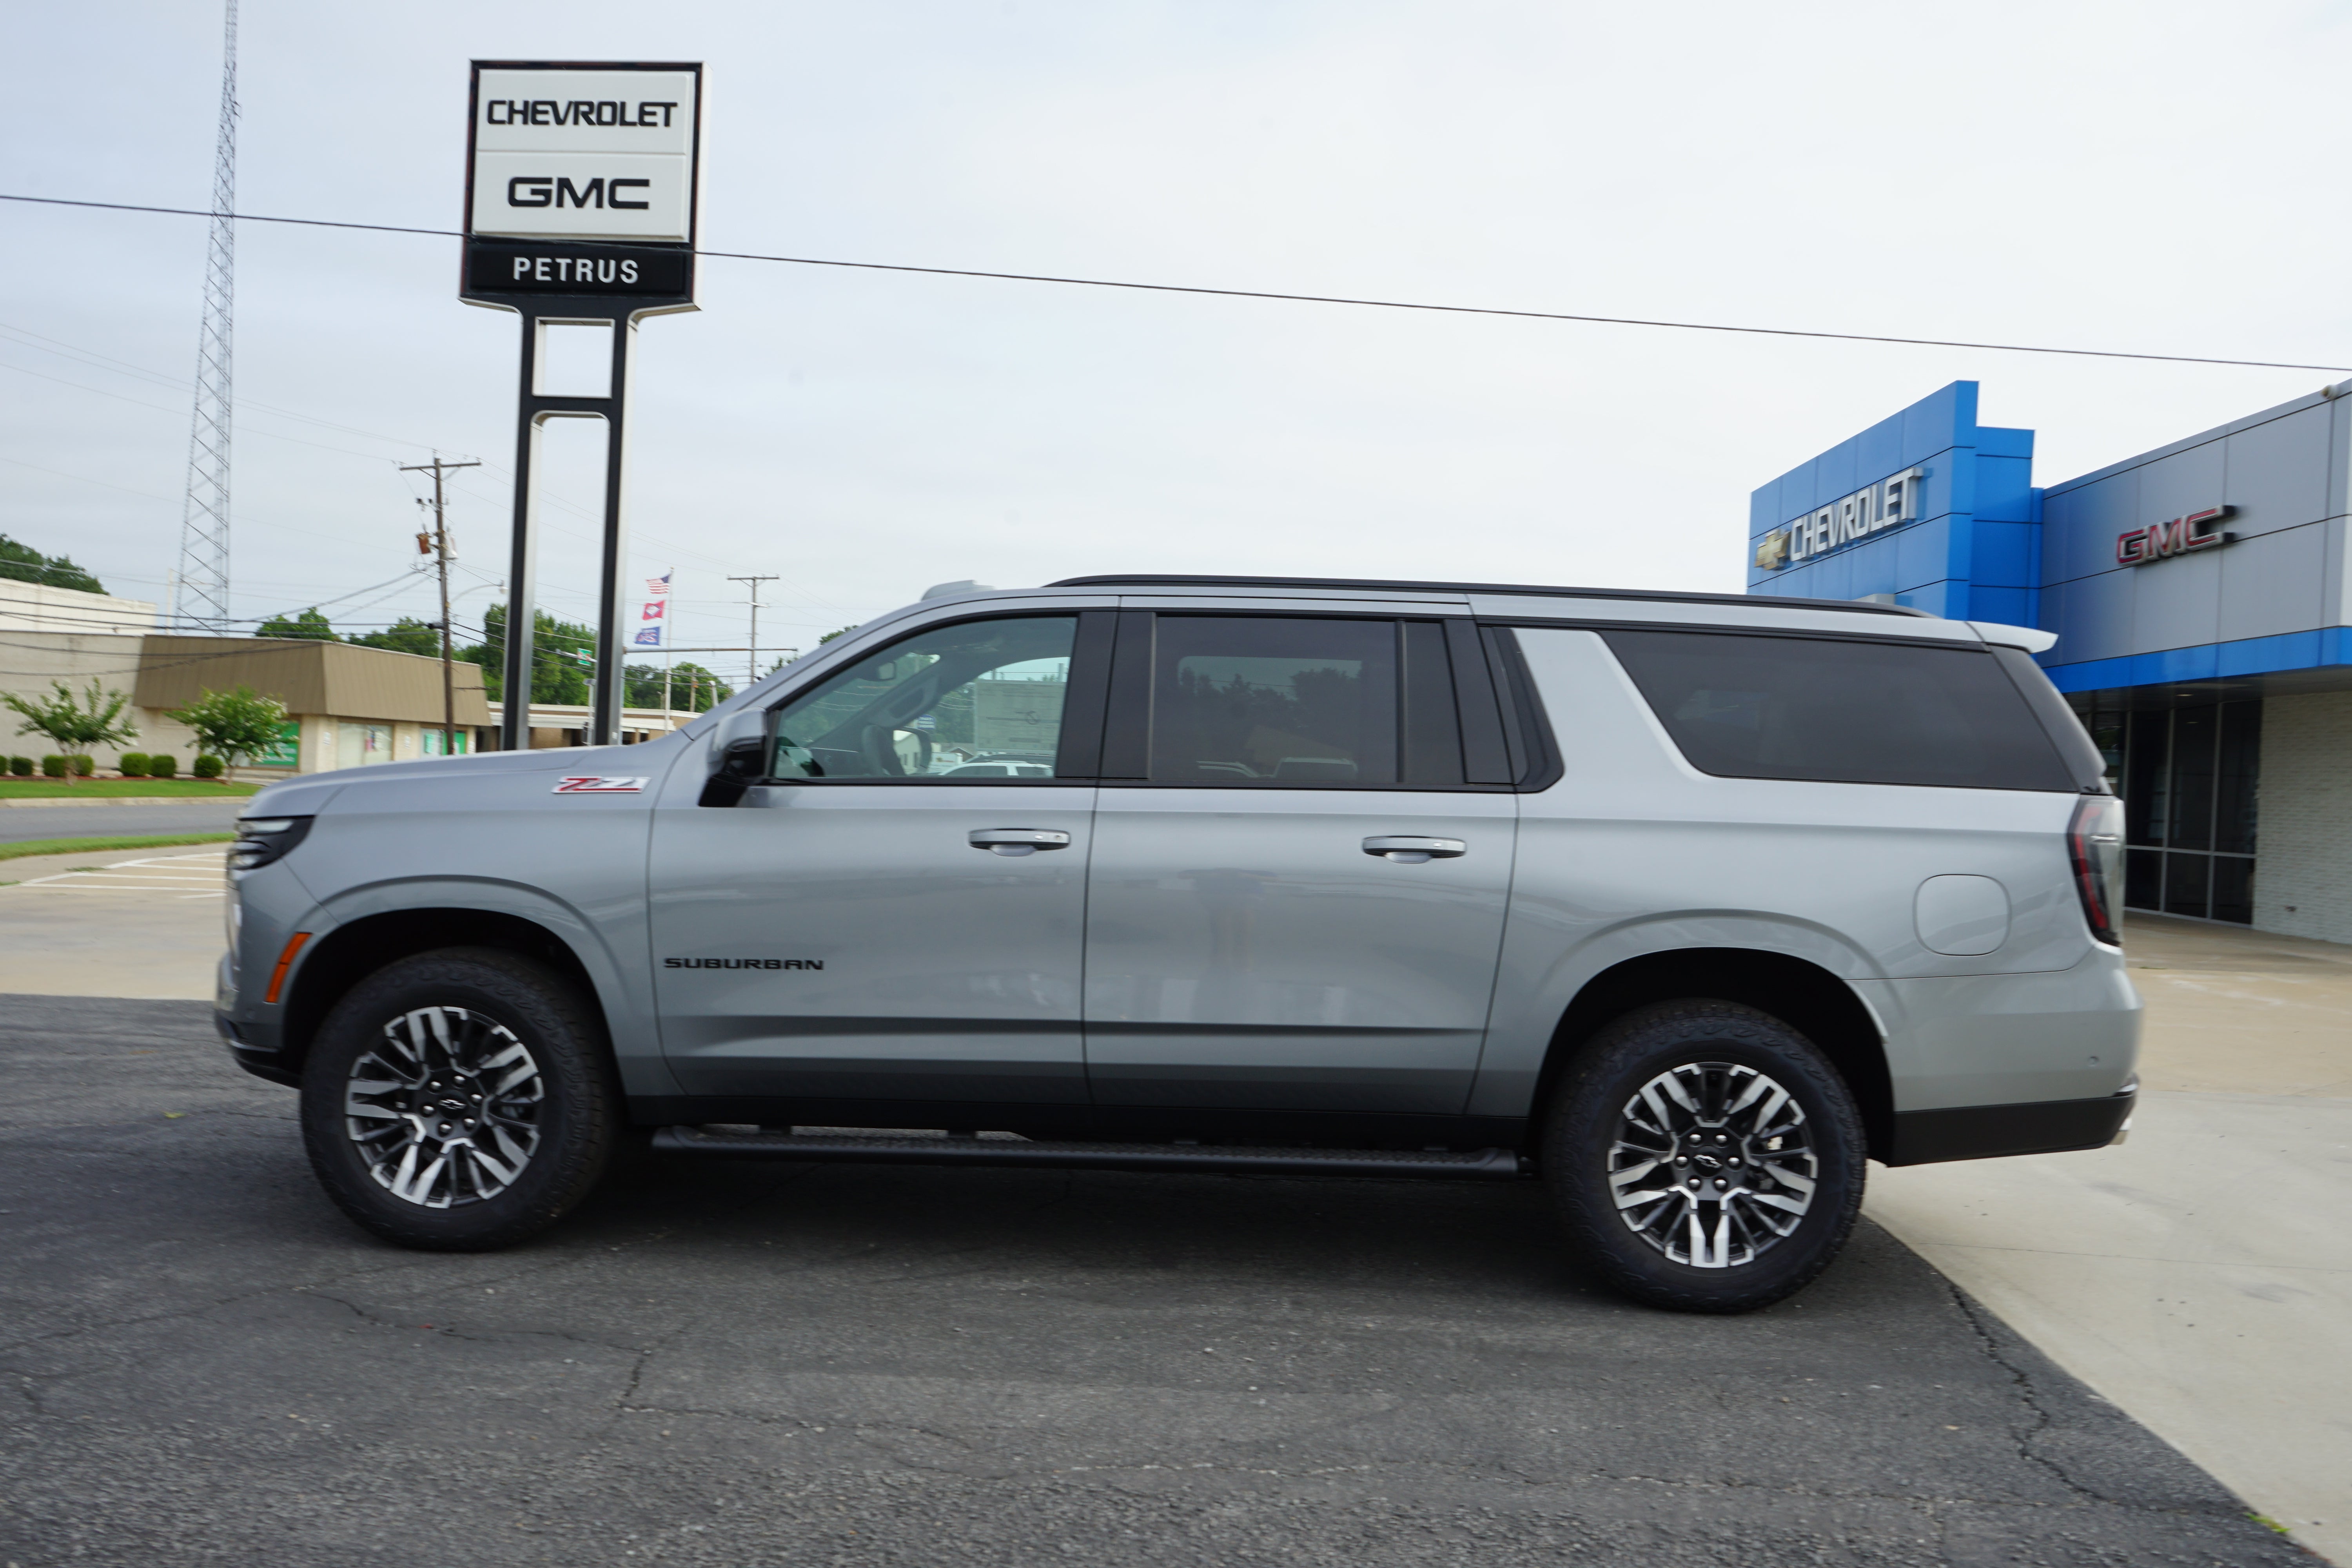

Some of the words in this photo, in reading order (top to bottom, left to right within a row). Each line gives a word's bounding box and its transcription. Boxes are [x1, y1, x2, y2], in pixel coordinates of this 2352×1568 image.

[487, 100, 678, 127] CHEVROLET
[507, 177, 650, 210] GMC
[513, 256, 639, 284] PETRUS
[1790, 467, 1924, 562] CHEVROLET
[2117, 505, 2234, 567] GMC
[664, 958, 824, 970] SUBURBAN
